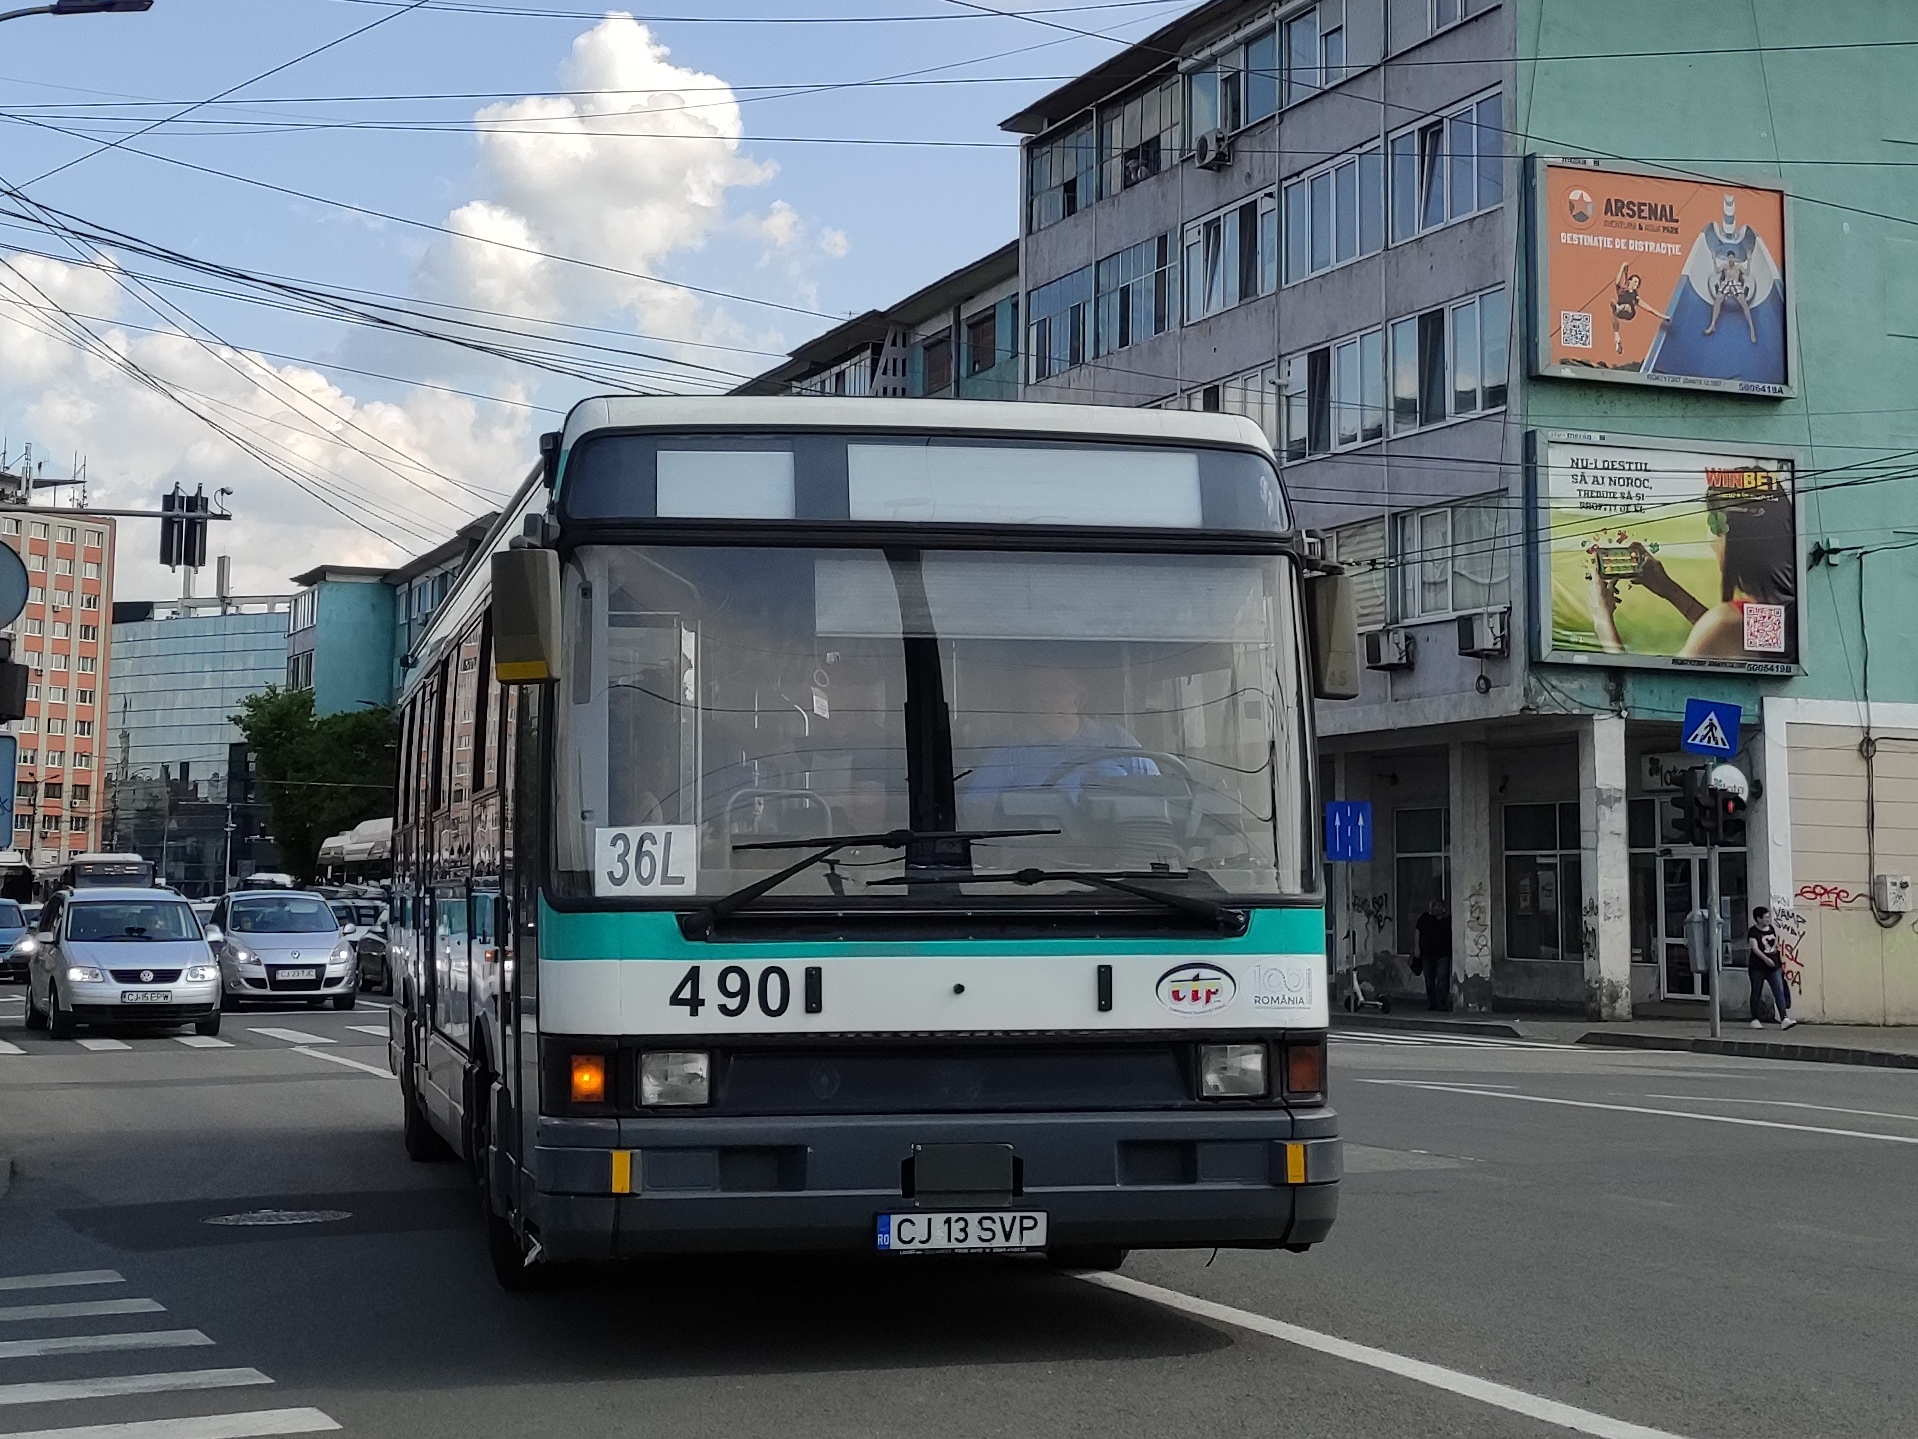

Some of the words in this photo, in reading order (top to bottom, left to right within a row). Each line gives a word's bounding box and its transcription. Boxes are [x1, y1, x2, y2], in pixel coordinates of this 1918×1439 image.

[1603, 198, 1680, 223] ARSENAL
[1614, 237, 1628, 250] DE
[1570, 457, 1598, 469] NU-I
[1602, 459, 1651, 472] DESTUL
[1704, 467, 1779, 491] WINBET
[606, 831, 686, 887] 36L
[668, 965, 791, 1018] 490
[1253, 993, 1306, 1006] ROMÂNIA
[877, 1233, 890, 1246] RO
[897, 1217, 933, 1245] CJ
[943, 1216, 969, 1244] 13
[976, 1215, 1039, 1245] SVP
